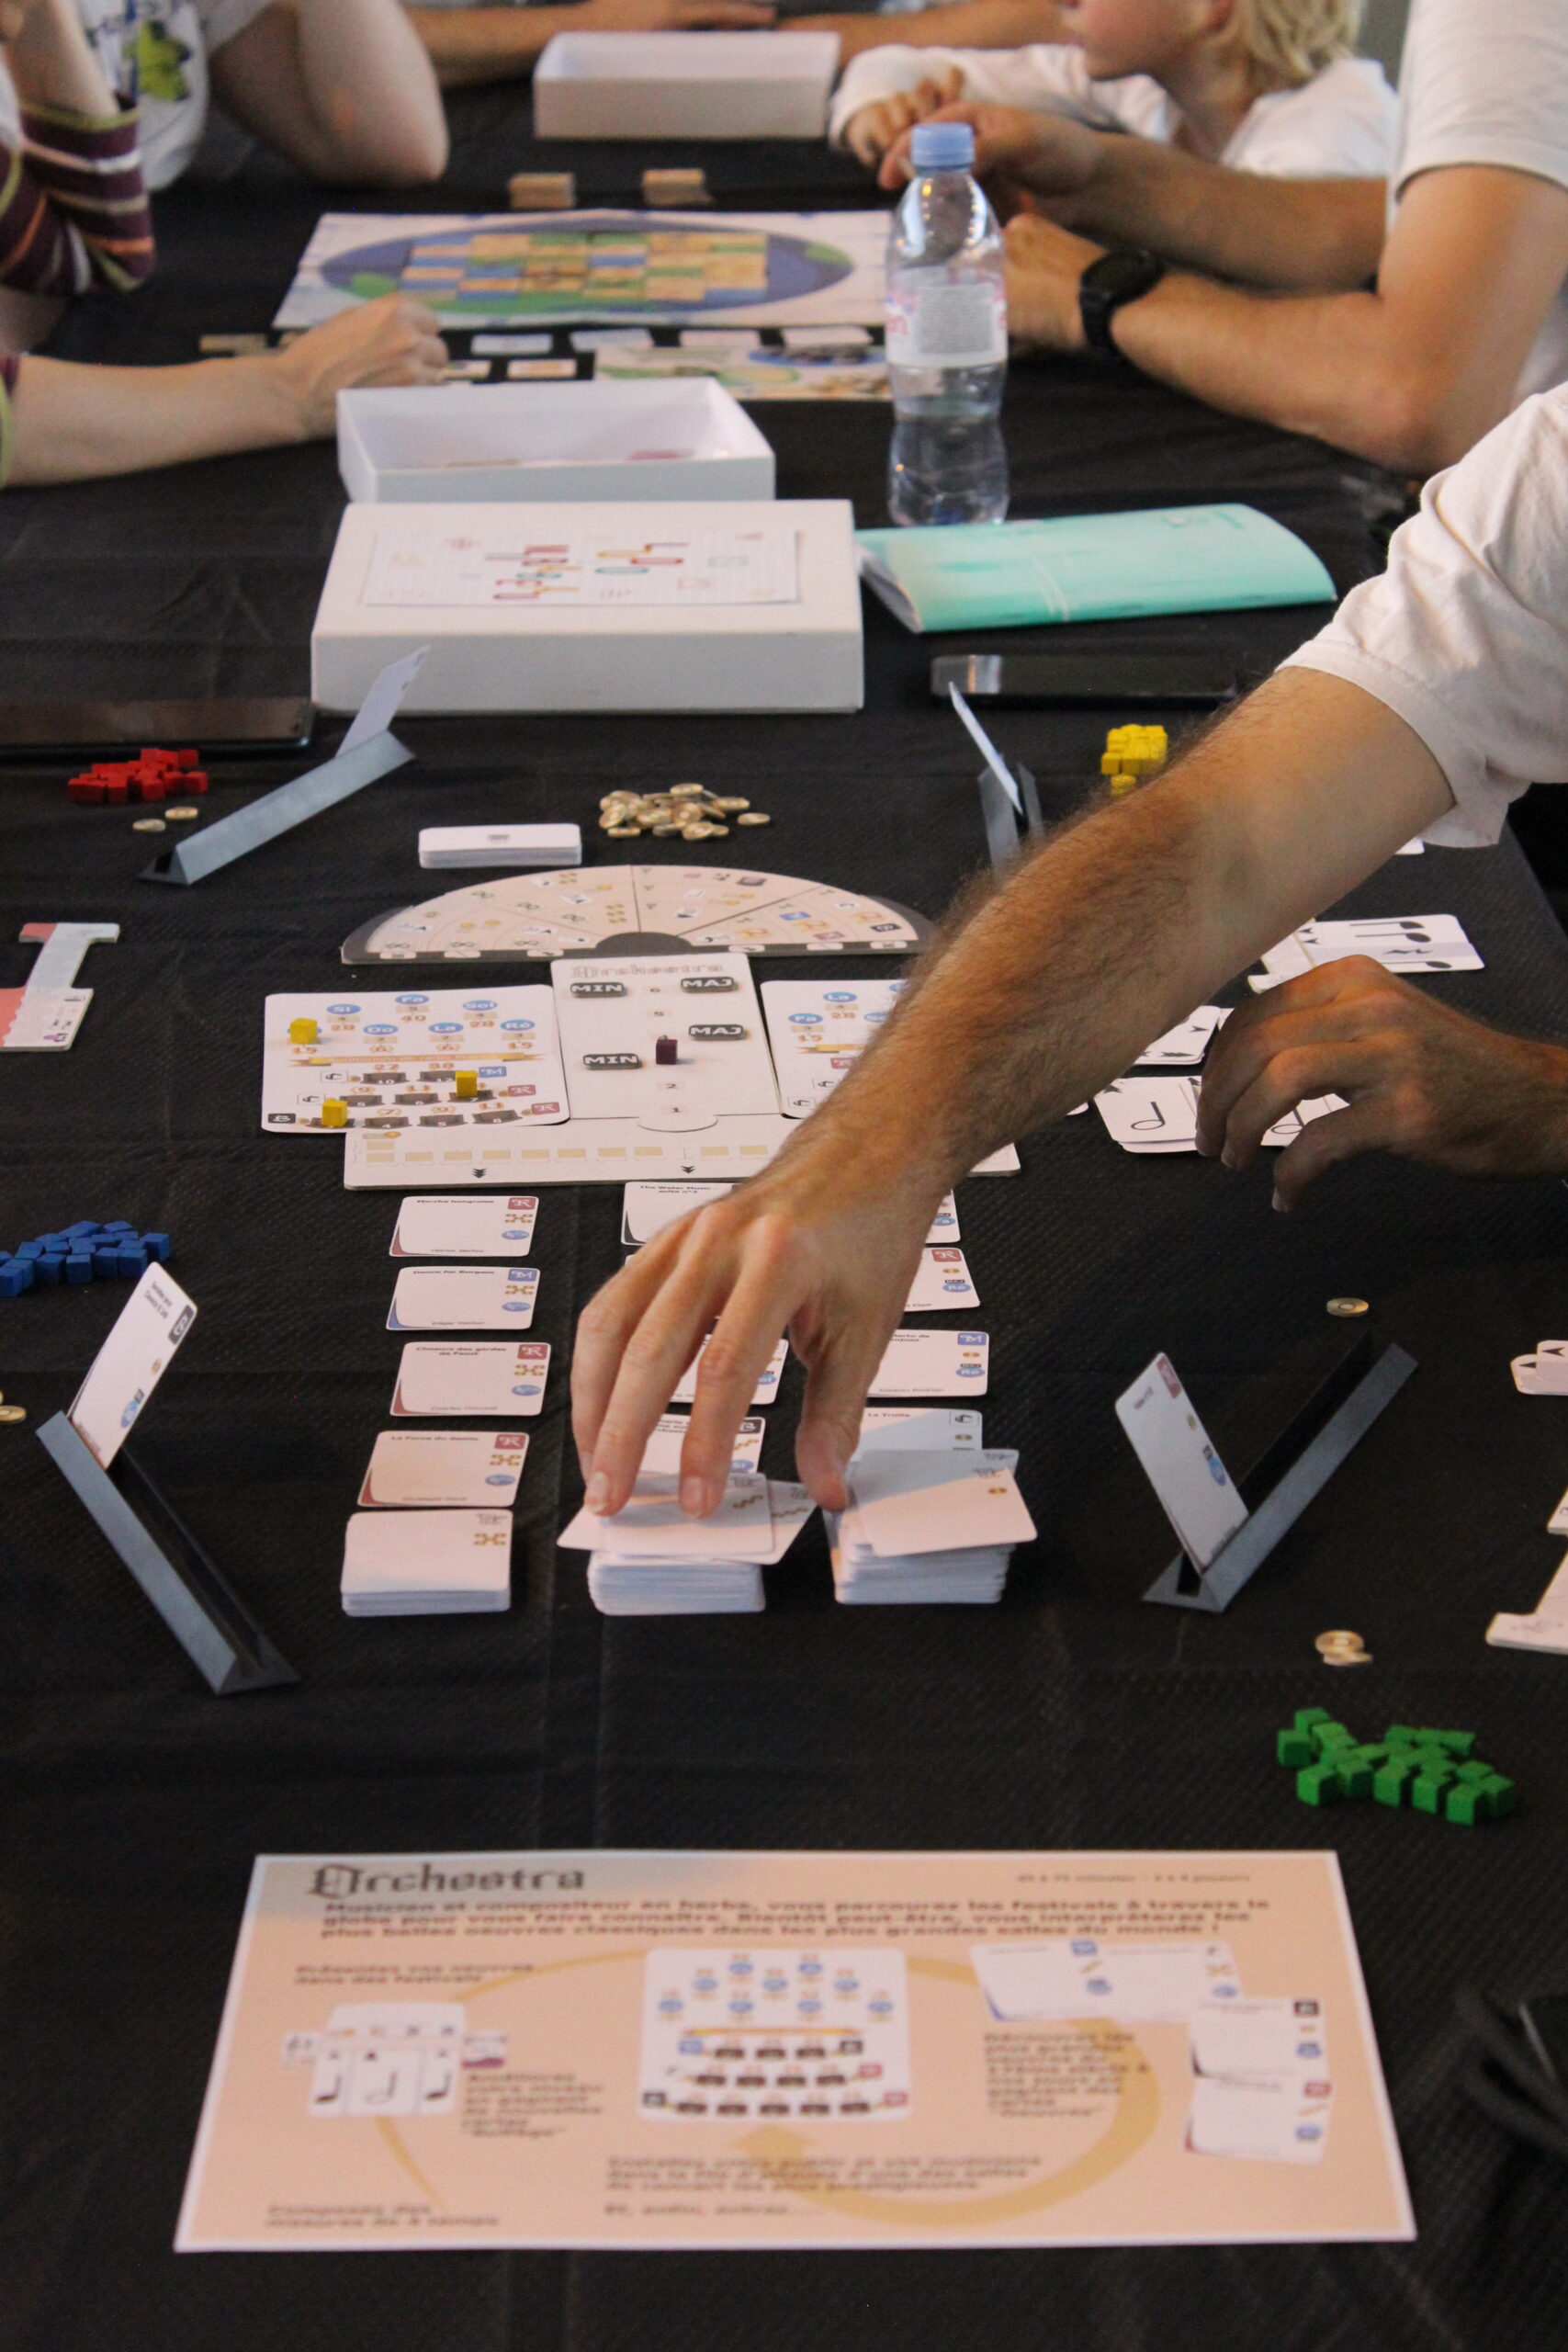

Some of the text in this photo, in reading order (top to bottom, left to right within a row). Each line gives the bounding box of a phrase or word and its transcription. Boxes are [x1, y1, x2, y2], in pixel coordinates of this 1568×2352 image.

[682, 978, 733, 988] MAJ
[572, 984, 623, 993] MIN
[400, 995, 423, 1003] Fa
[400, 1014, 427, 1023] 40
[691, 1026, 741, 1035] MAJ
[585, 1054, 637, 1065] MIN
[310, 1863, 585, 1899] Orchestra
[325, 1901, 436, 1912] Musicien
[442, 1901, 467, 1912] et
[475, 1900, 631, 1913] compositeur
[640, 1901, 671, 1911] en
[768, 1901, 826, 1911] vous
[835, 1901, 959, 1913] parcourez
[968, 1899, 1004, 1911] les
[1011, 1899, 1118, 1911] festivals
[1148, 1899, 1239, 1911] travers
[1247, 1898, 1269, 1910] le
[324, 1914, 391, 1927] globe
[401, 1915, 456, 1926] pour
[468, 1915, 525, 1924] vous
[534, 1913, 591, 1924] faire
[738, 1912, 826, 1923] Bientôt
[972, 1914, 1030, 1923] vous
[1214, 1912, 1250, 1922] les
[321, 1928, 373, 1940] plus
[382, 1927, 456, 1938] belles
[573, 1926, 704, 1938] classiques
[713, 1925, 773, 1937] dans
[781, 1925, 817, 1936] les
[825, 1925, 877, 1938] plus
[886, 1926, 987, 1938] grandes
[997, 1925, 1068, 1936] salles
[1077, 1925, 1108, 1936] du
[1116, 1924, 1202, 1936] monde
